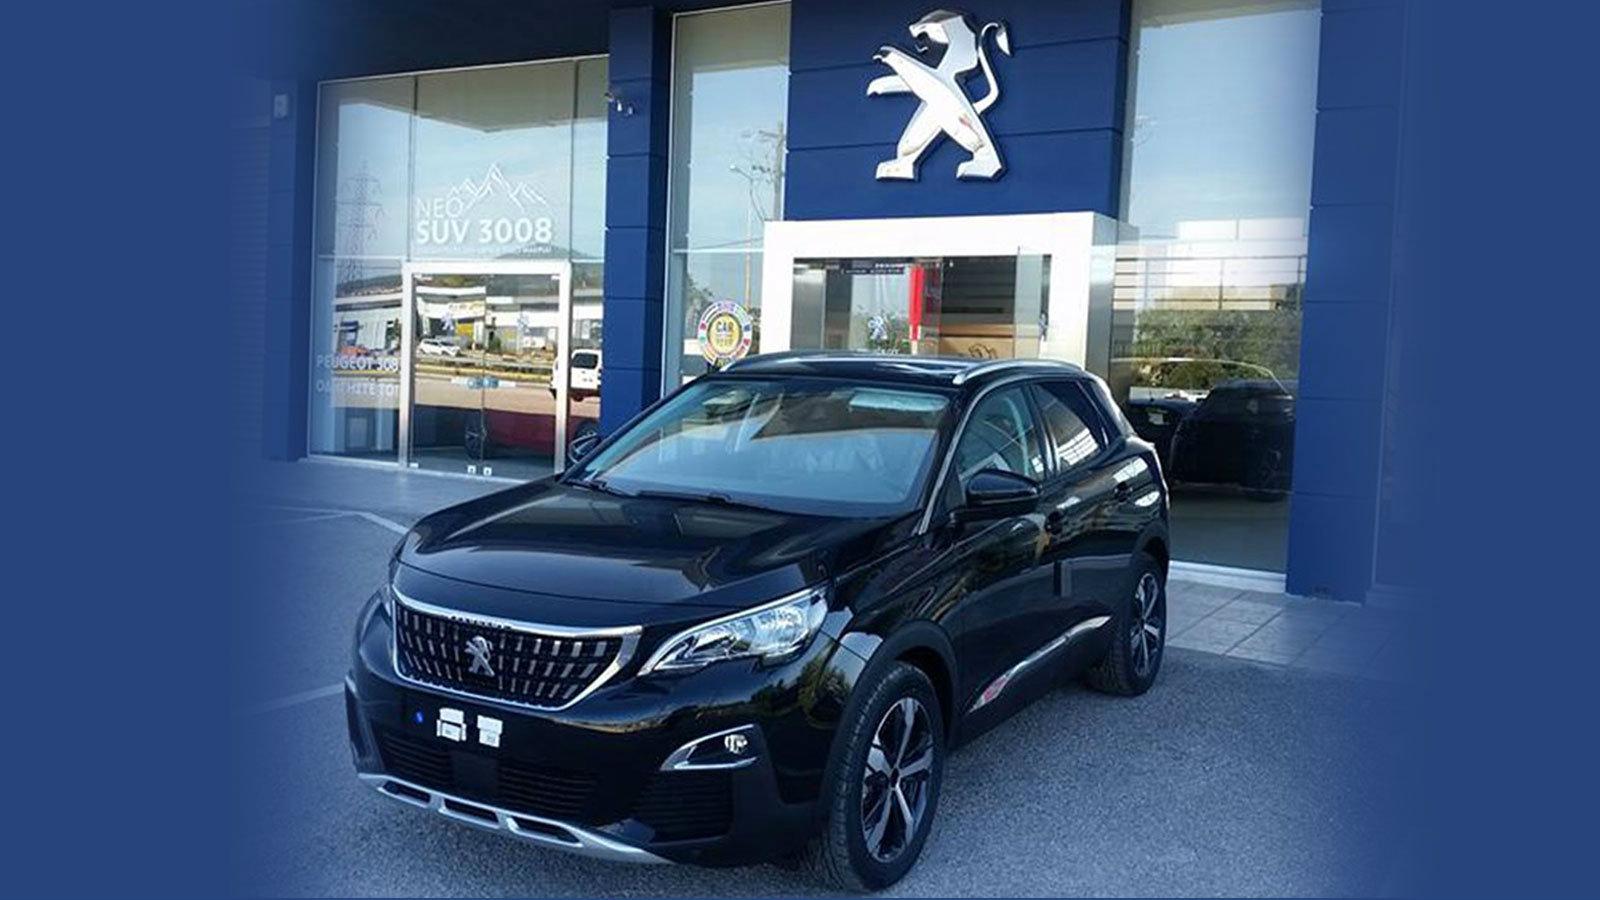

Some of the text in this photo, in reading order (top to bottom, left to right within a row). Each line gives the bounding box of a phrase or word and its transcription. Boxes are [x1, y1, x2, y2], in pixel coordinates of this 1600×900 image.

[416, 217, 553, 244] SUV 3008
[316, 354, 374, 370] PEUGEOT
